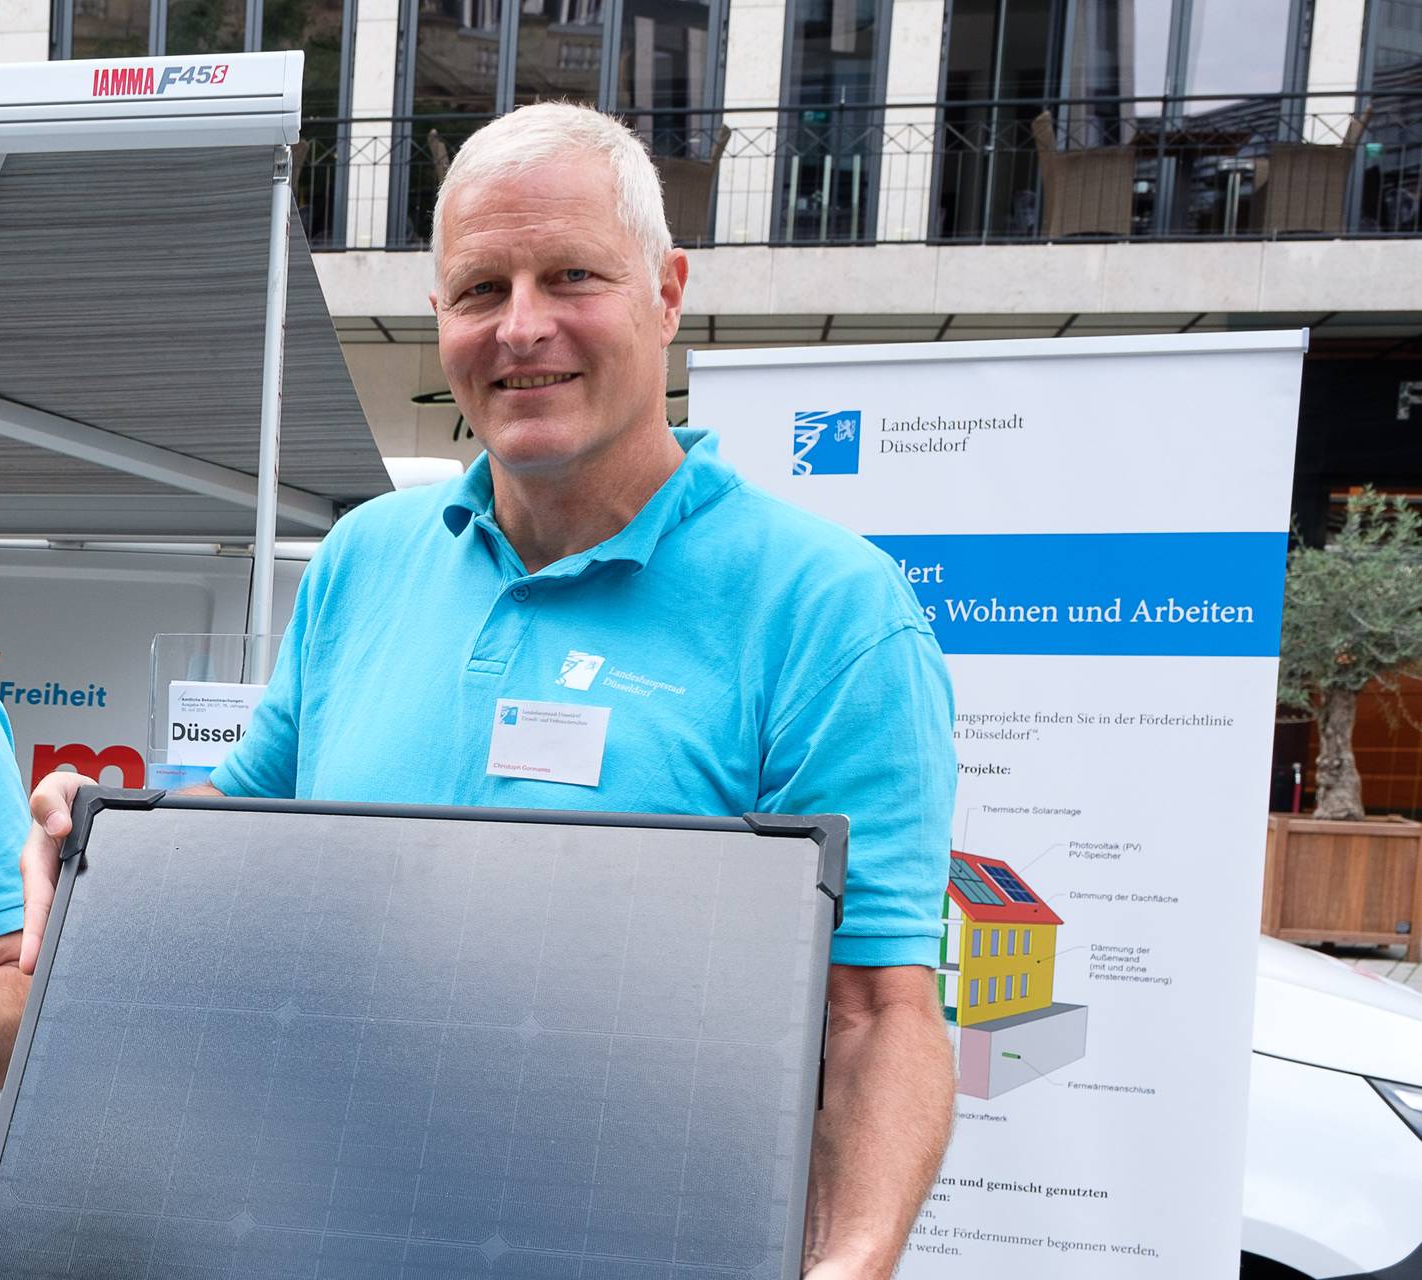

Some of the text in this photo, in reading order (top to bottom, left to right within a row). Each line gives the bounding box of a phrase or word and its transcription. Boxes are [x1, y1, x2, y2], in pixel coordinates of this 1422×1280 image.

[881, 413, 1024, 434] Landeshauptstadt
[880, 437, 970, 453] Düsseldorf
[944, 597, 1058, 623] Wohnen
[1068, 598, 1122, 623] und
[1130, 598, 1254, 623] Arbeiten
[0, 681, 107, 708] Freiheit
[955, 711, 1234, 727] ungsprojekte finden Sie in der Förderichtlinie
[172, 722, 246, 743] Düssel
[957, 763, 1012, 776] Projekte:
[982, 805, 1082, 817] Thermische Solaranlage
[1069, 841, 1142, 852] Photovoltaik (PV)
[1068, 850, 1121, 860] PV-Speicher
[1069, 891, 1179, 904] Dämmung der Dachfläche
[1090, 943, 1150, 955] Dämmung der
[1090, 953, 1140, 963] Außenwand
[1089, 963, 1147, 973] (mit und ohne
[1067, 1081, 1156, 1095] Fernwärmeanschluss
[960, 1177, 983, 1188] und
[986, 1181, 1042, 1194] gemischt
[1045, 1186, 1108, 1199] genutzten
[930, 1225, 949, 1237] der
[953, 1227, 1044, 1247] Fördernummer
[1047, 1236, 1107, 1252] begonnen
[1110, 1244, 1159, 1258] werden,
[916, 1243, 962, 1256] werden.
